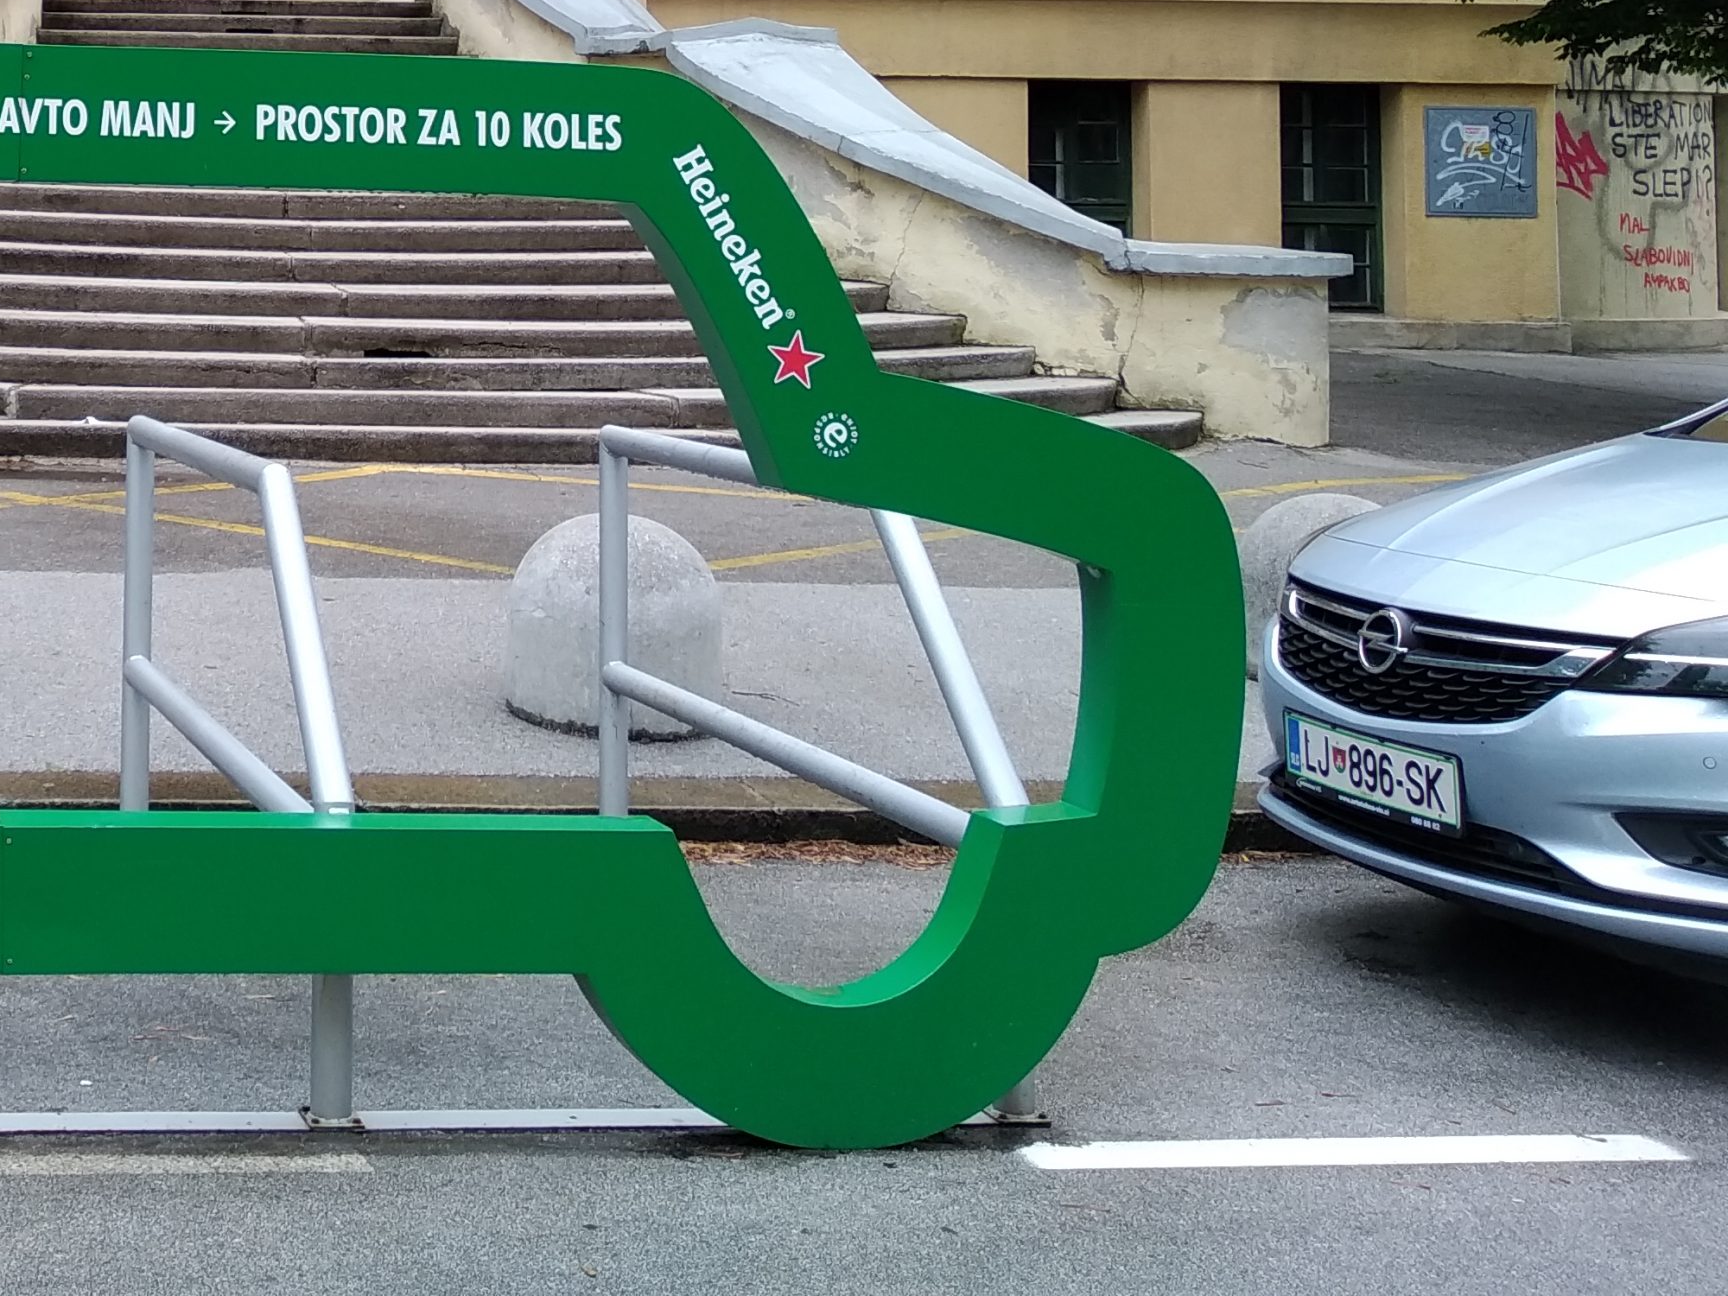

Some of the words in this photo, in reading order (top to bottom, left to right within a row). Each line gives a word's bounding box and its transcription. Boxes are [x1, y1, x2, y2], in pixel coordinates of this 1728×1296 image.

[99, 100, 196, 139] MANJ
[255, 104, 407, 145] PROSTOR
[416, 108, 461, 147] ZA
[474, 110, 511, 148] 10
[522, 112, 622, 151] KOLES
[1612, 133, 1661, 159] STE
[1674, 131, 1712, 161] MAR
[673, 144, 784, 329] Heineken
[1348, 743, 1447, 814] 896-SK
